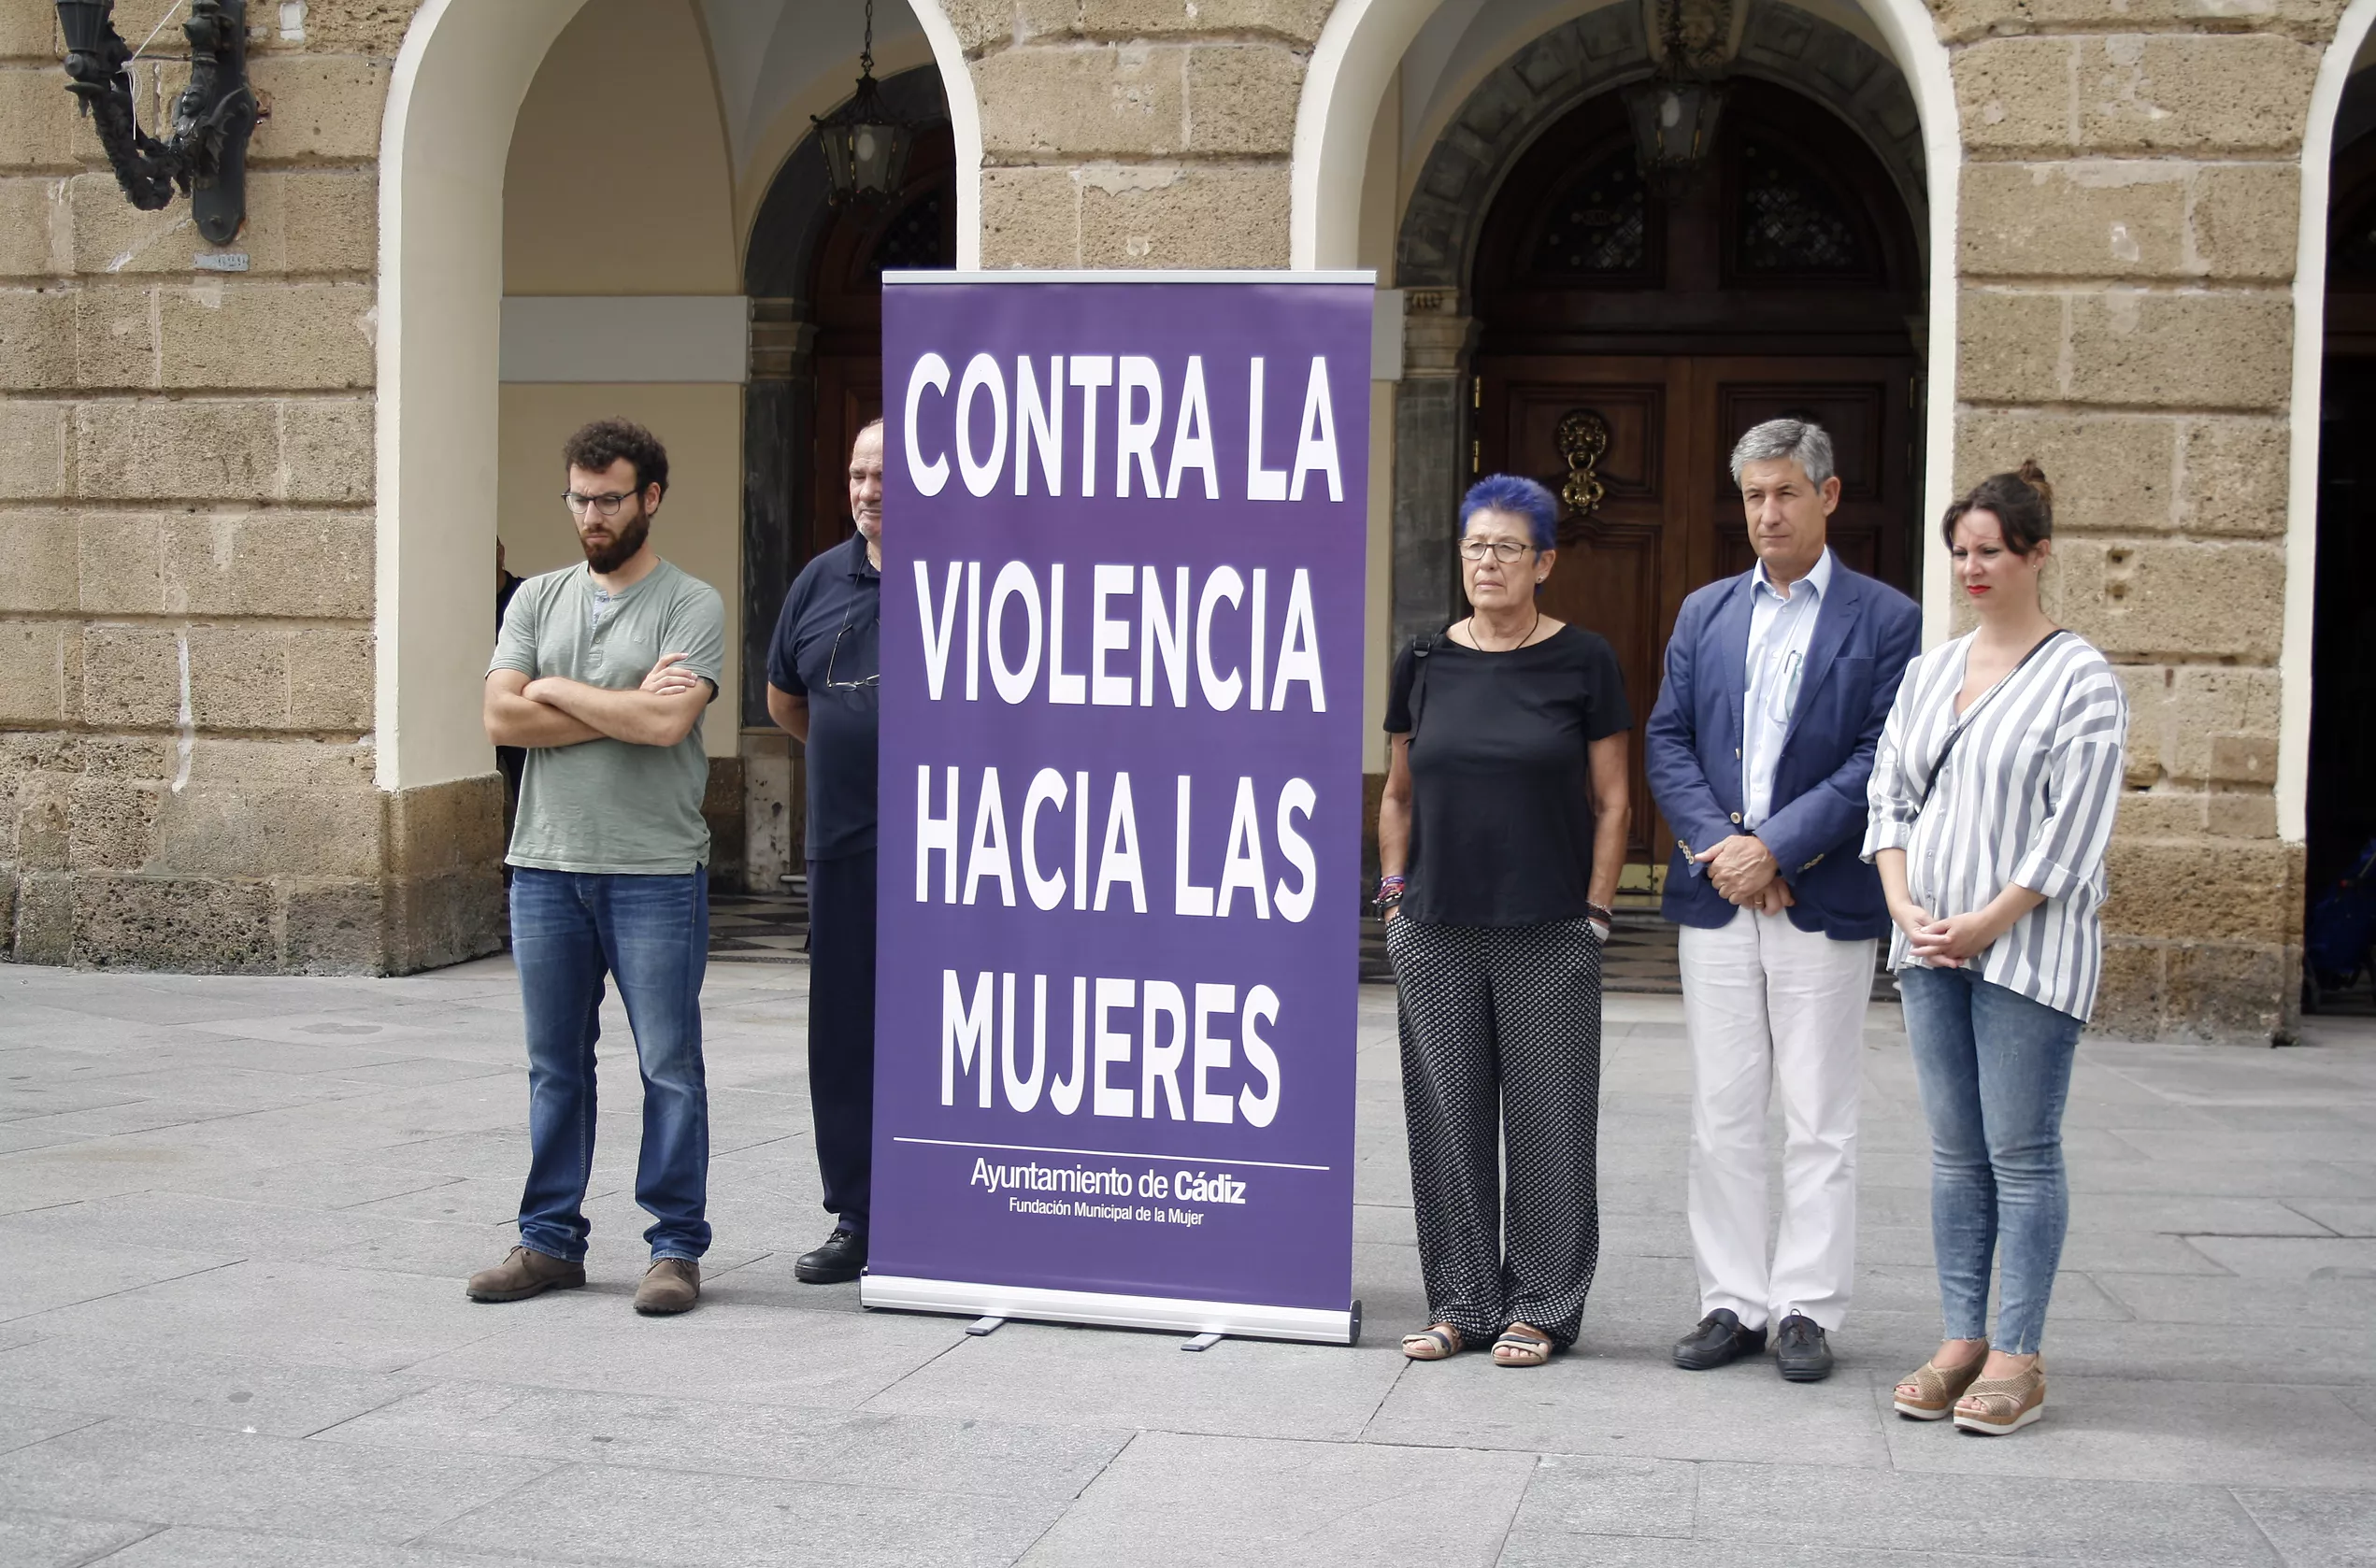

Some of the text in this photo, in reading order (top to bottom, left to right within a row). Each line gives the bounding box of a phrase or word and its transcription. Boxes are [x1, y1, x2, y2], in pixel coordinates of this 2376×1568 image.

[904, 352, 1344, 503] CONTRA LA
[913, 560, 1326, 713] VIOLENCIA
[915, 764, 1317, 923] HACIA LAS
[941, 969, 1281, 1128] MUJERES
[970, 1157, 1247, 1205] Ayuntamiento de Cádiz
[1009, 1197, 1205, 1229] Fundación Municipal de la Mujer
